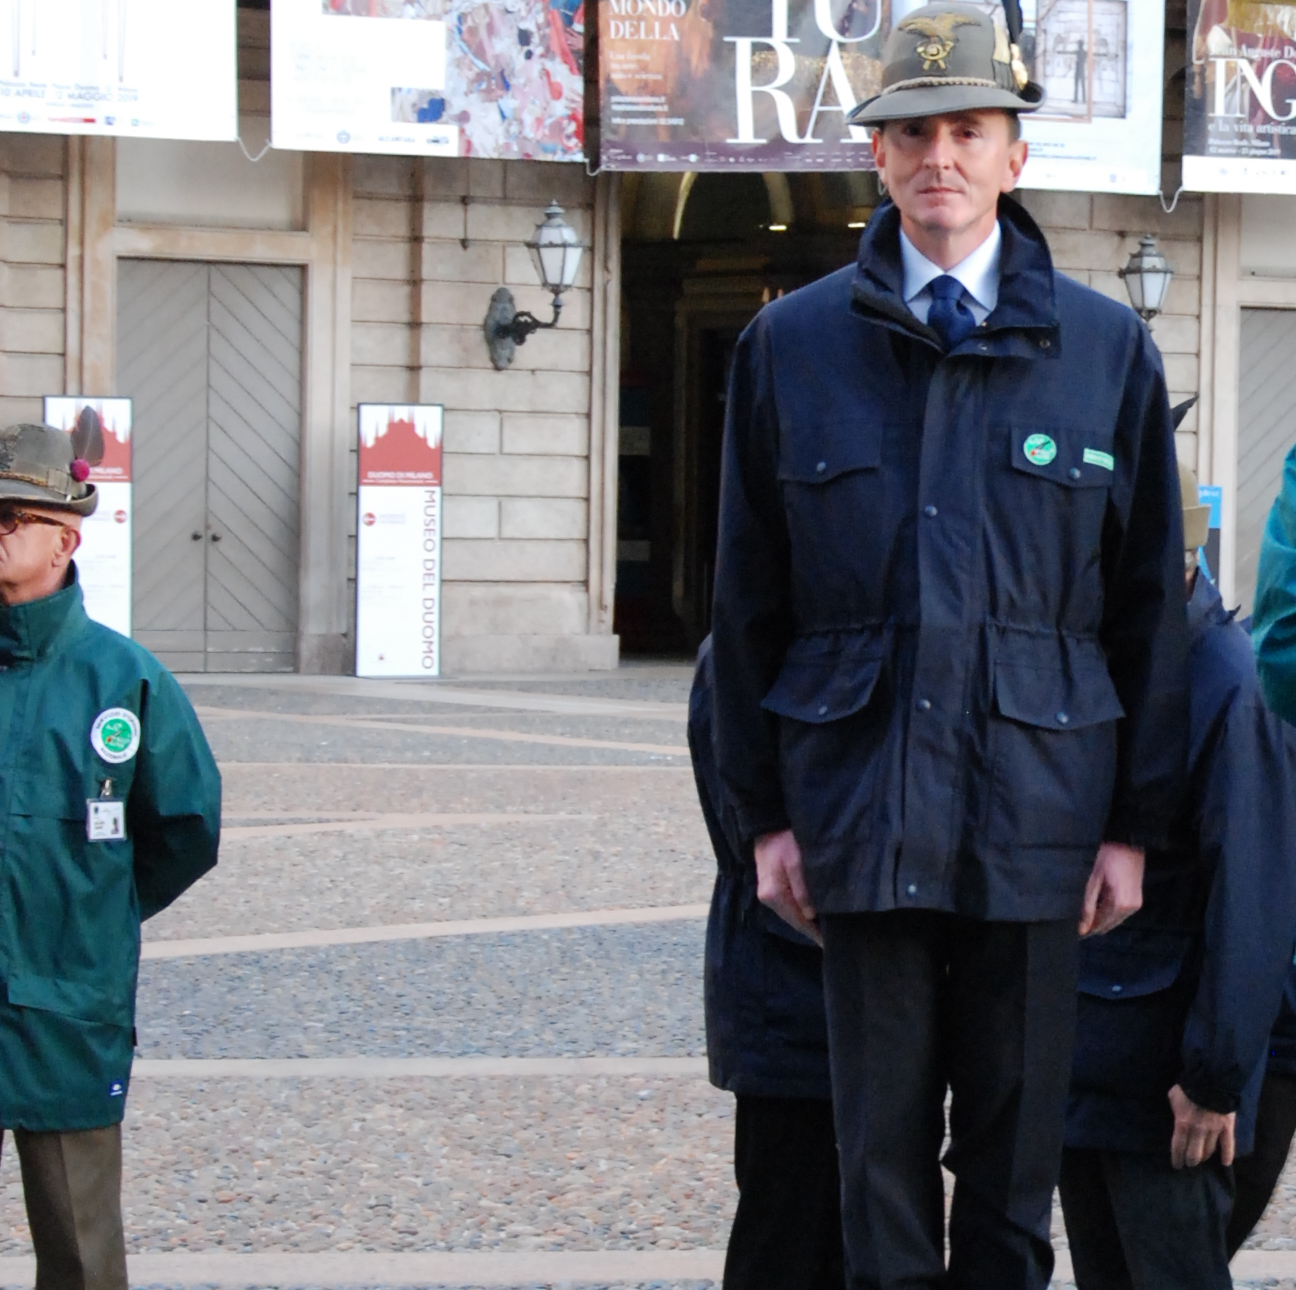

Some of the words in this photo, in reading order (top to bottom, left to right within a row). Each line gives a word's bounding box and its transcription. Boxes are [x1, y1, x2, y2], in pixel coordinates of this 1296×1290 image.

[609, 20, 680, 41] DELLA
[1218, 120, 1230, 133] la
[1233, 121, 1254, 133] vita
[422, 490, 437, 553] MUSEO
[421, 558, 436, 592] DEL
[421, 597, 436, 670] DUOMO
